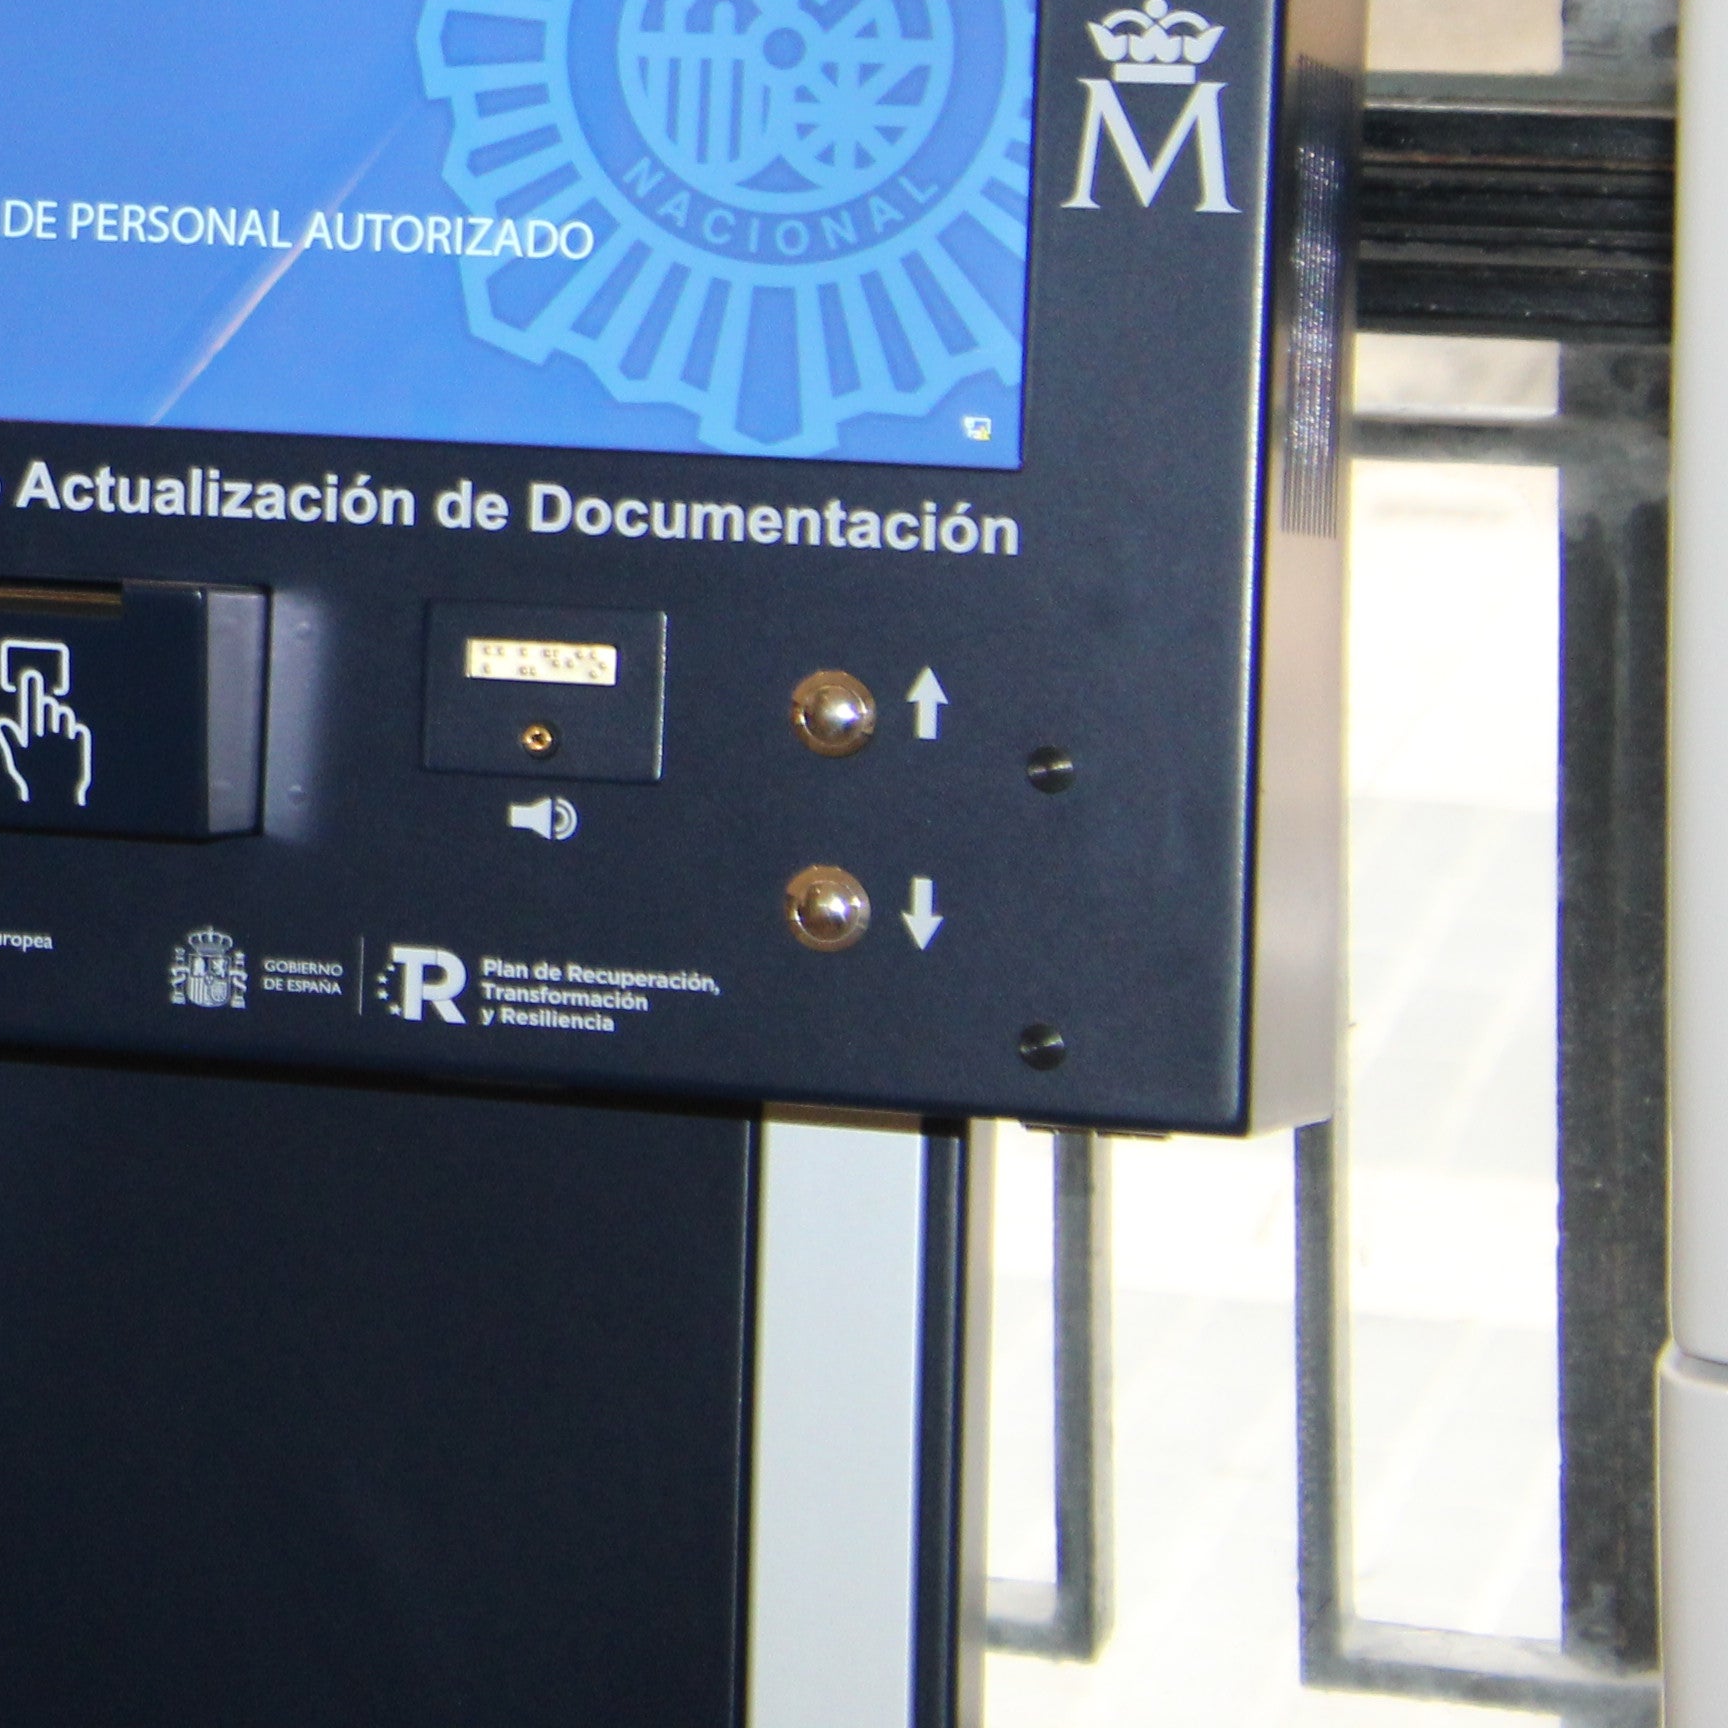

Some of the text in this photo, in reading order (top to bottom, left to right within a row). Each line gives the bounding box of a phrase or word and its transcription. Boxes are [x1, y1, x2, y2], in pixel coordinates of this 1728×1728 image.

[624, 156, 938, 256] NACIONAL
[2, 199, 58, 239] DE
[70, 201, 292, 249] PERSONAL
[304, 210, 594, 260] AUTORIZADO
[15, 460, 415, 526] Actualización
[435, 478, 509, 531] de
[529, 482, 1019, 556] Documentación
[263, 958, 344, 977] GOBIERNO
[481, 957, 721, 996] Plan de Recuperación,
[262, 977, 342, 995] DE ESPAÑA
[480, 981, 650, 1012] Transformación
[481, 1006, 616, 1032] y Resiliencia
